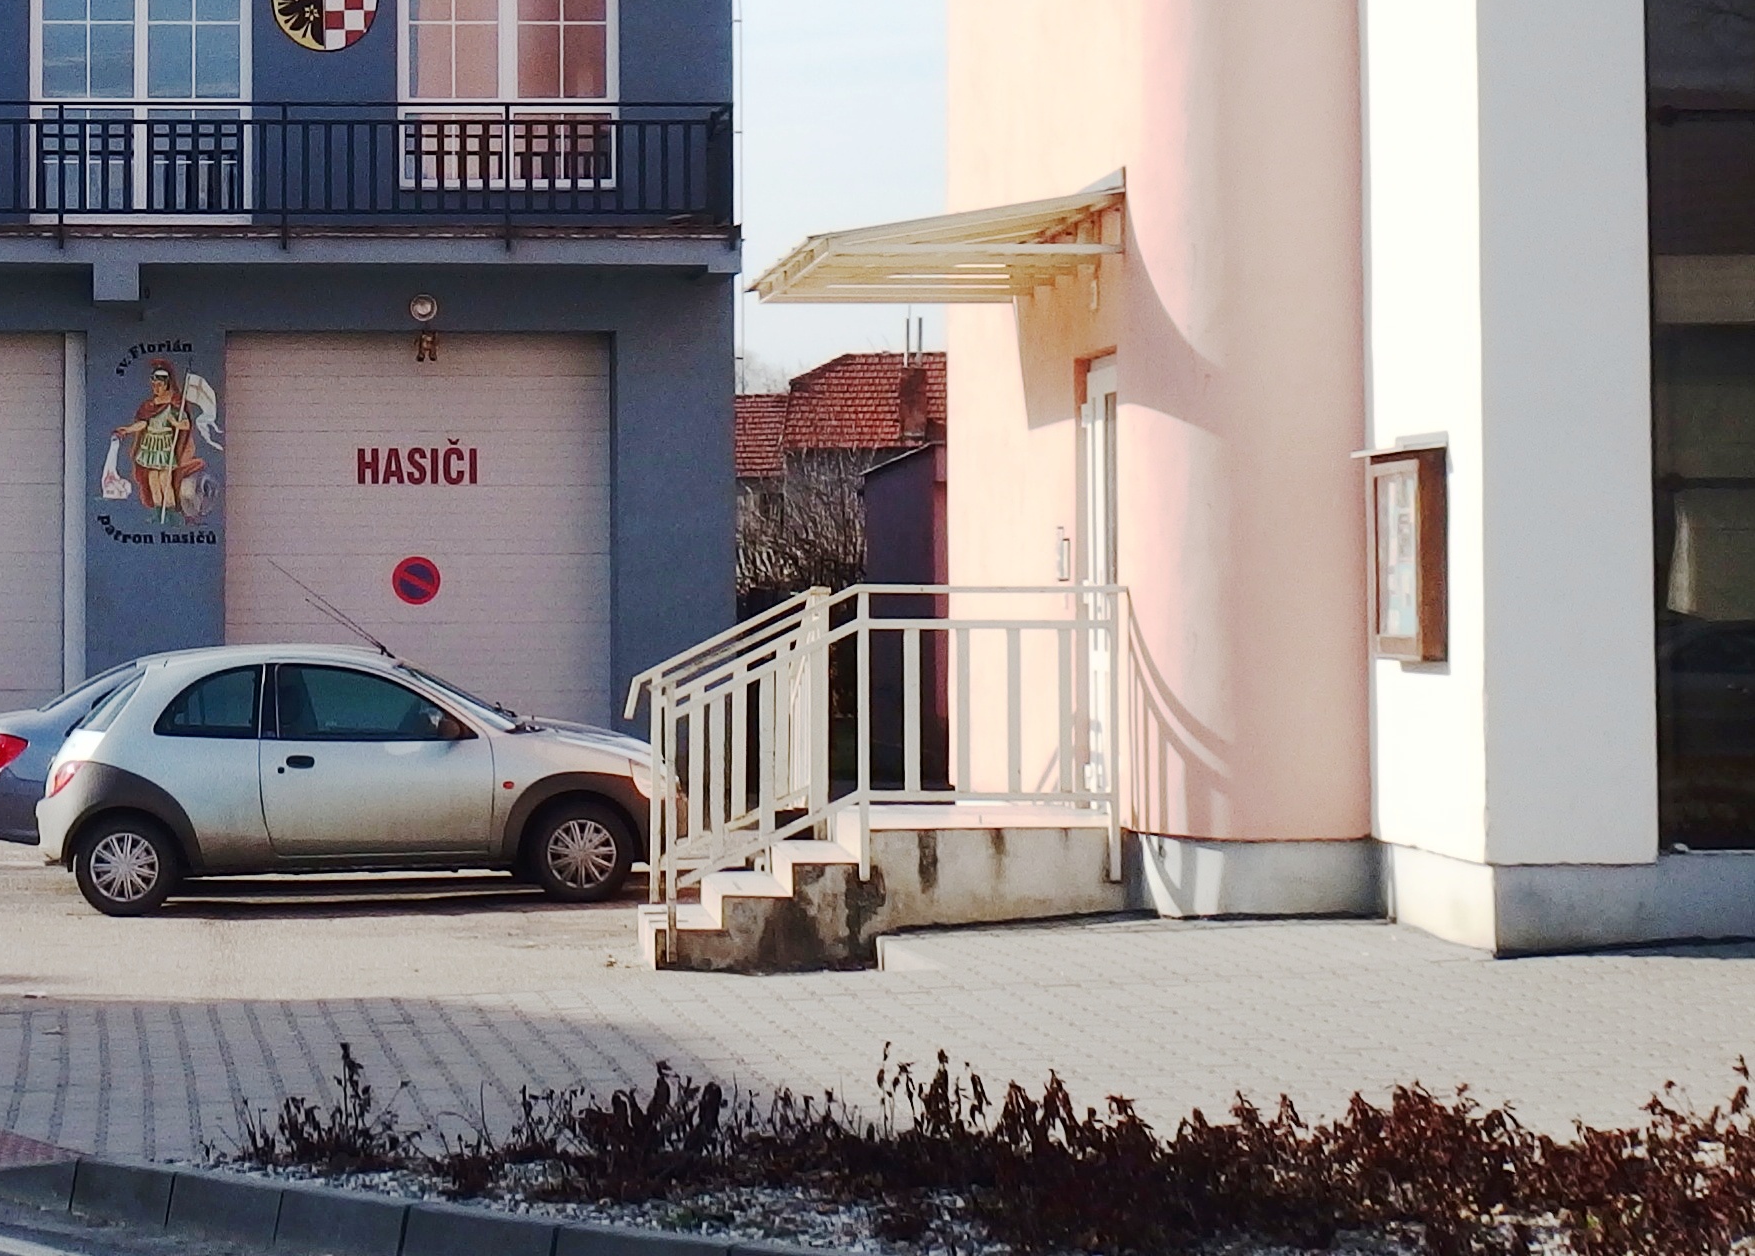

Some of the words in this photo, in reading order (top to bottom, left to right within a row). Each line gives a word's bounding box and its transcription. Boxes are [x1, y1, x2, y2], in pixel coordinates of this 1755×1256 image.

[129, 339, 192, 359] Florián
[357, 438, 478, 485] HASIČI
[160, 530, 217, 544] hasičů
